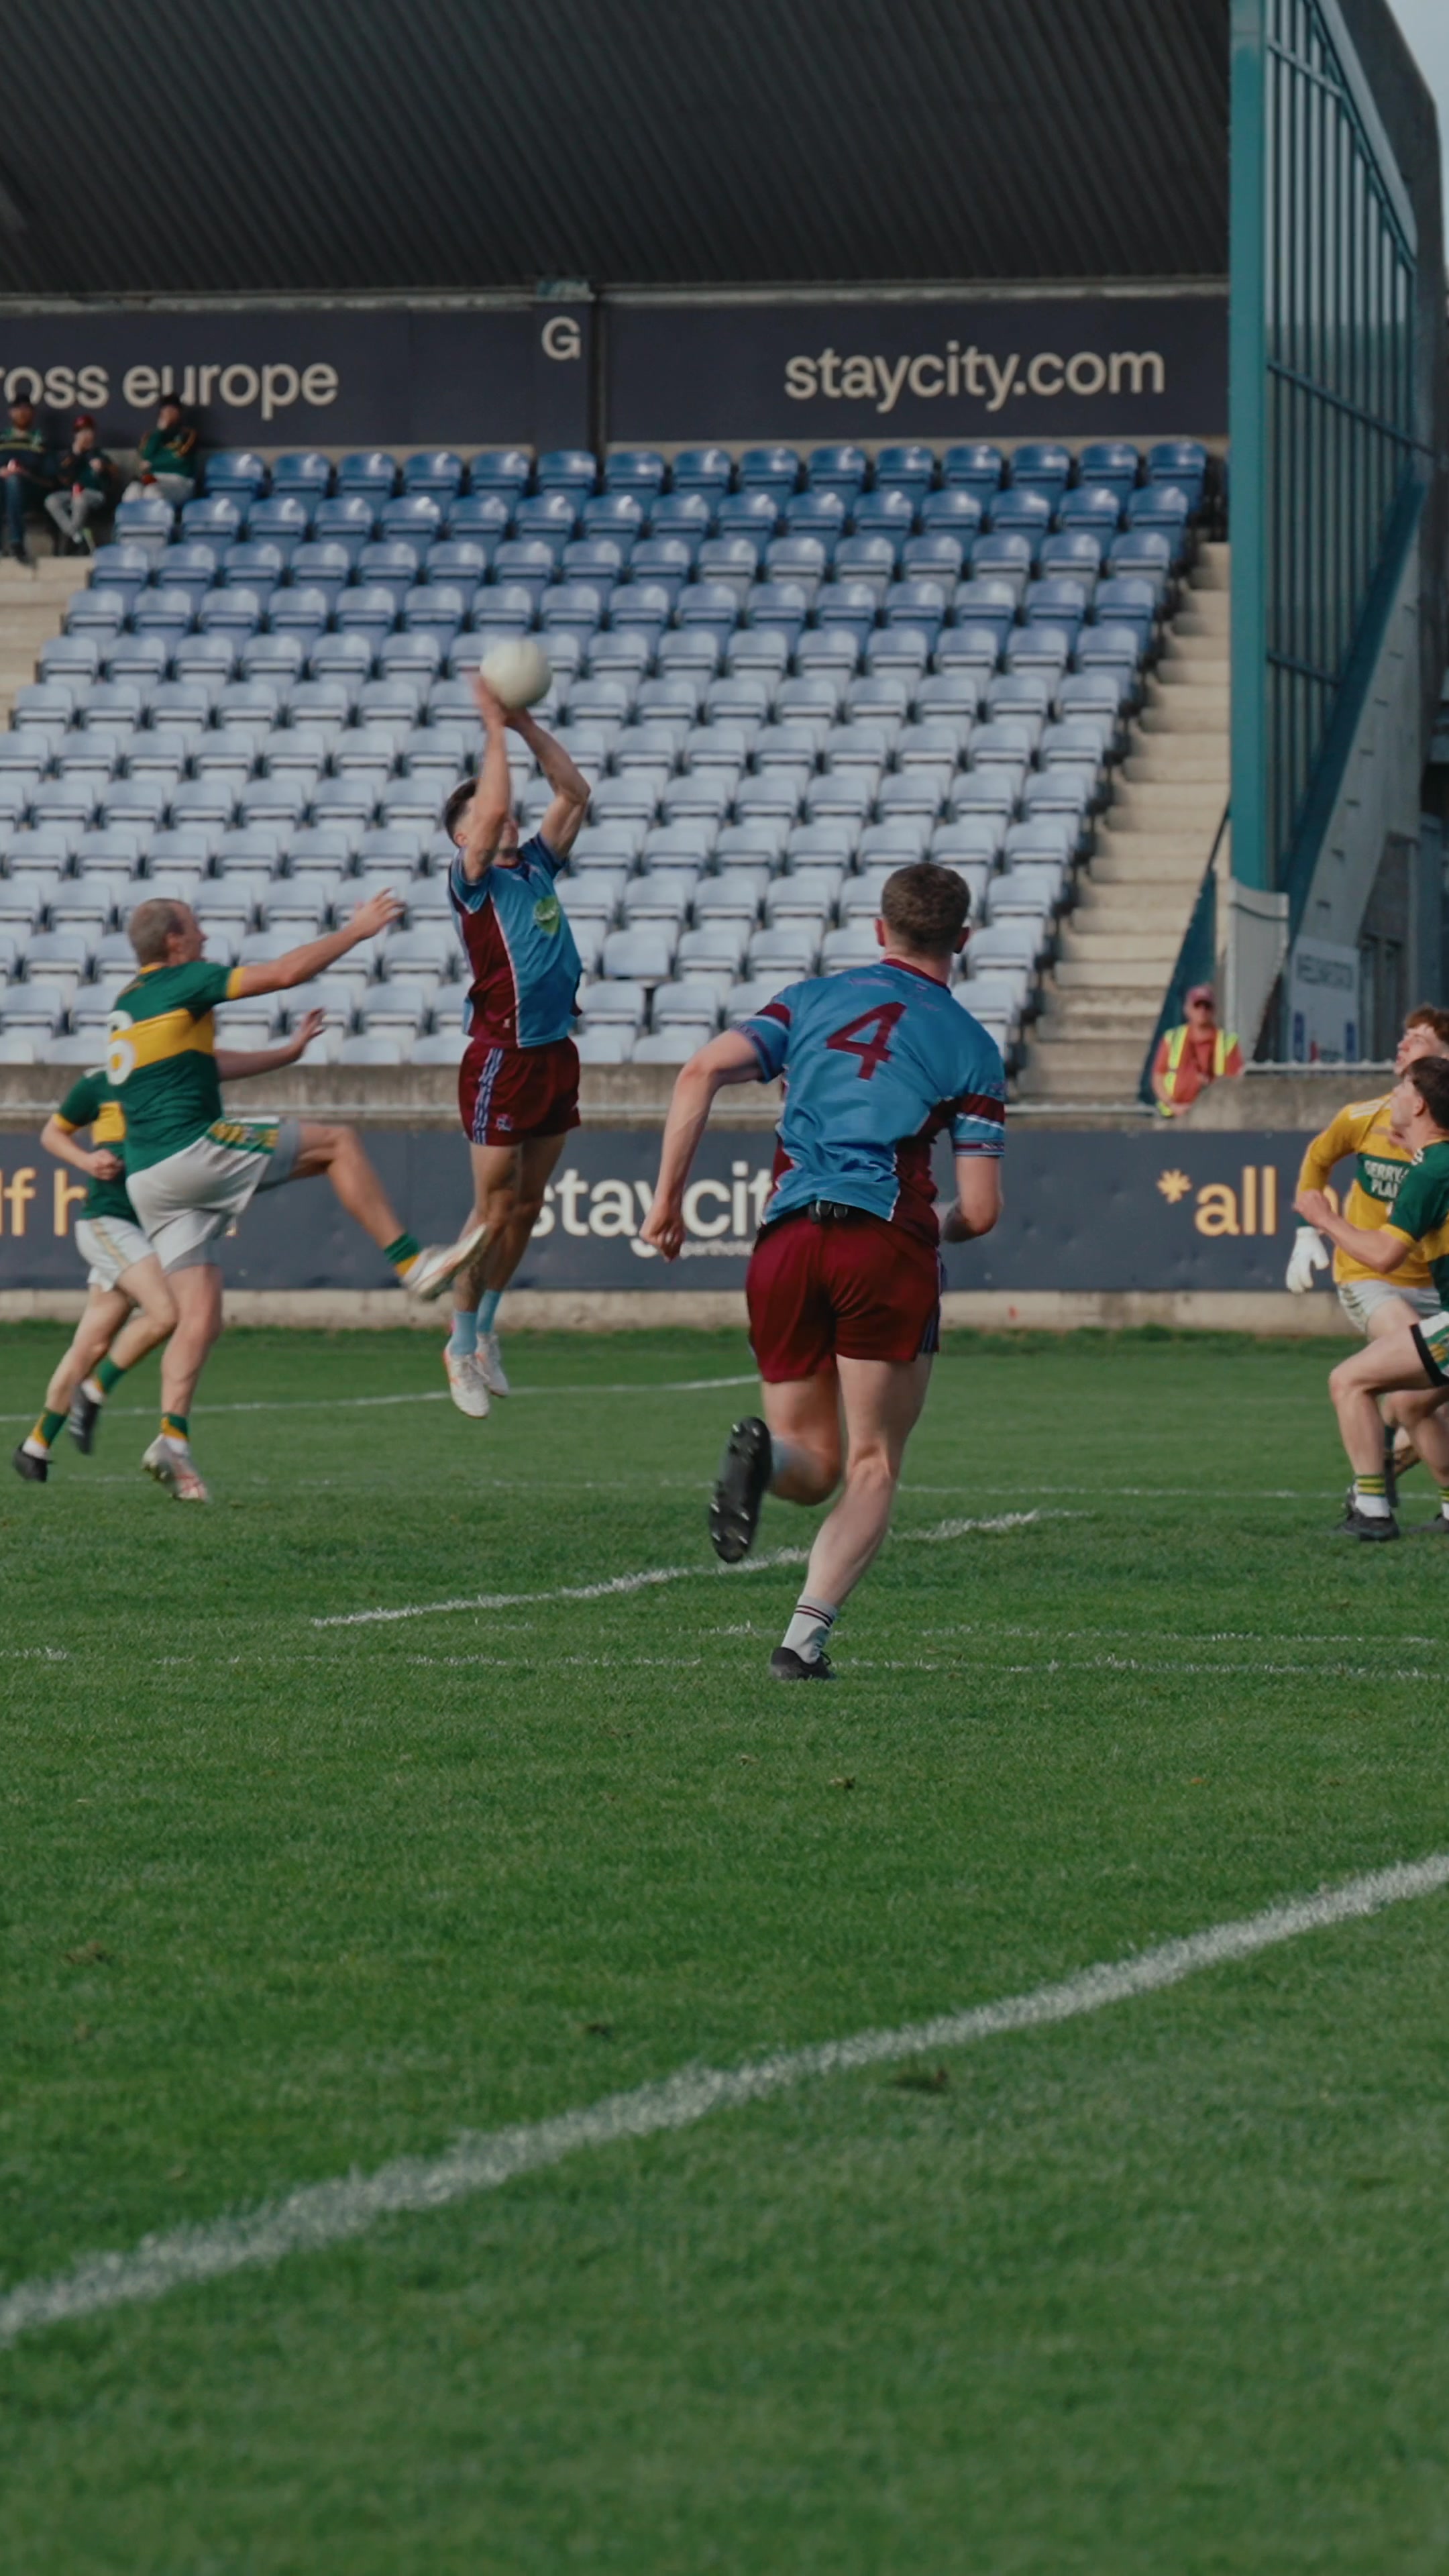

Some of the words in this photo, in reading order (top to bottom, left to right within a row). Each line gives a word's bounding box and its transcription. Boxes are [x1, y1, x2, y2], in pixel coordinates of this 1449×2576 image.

[541, 316, 581, 360] G
[0, 366, 109, 409] oss
[123, 363, 338, 421] europe
[784, 340, 1165, 413] staycity.com
[826, 1002, 907, 1081] 4
[531, 1161, 771, 1258] staycit
